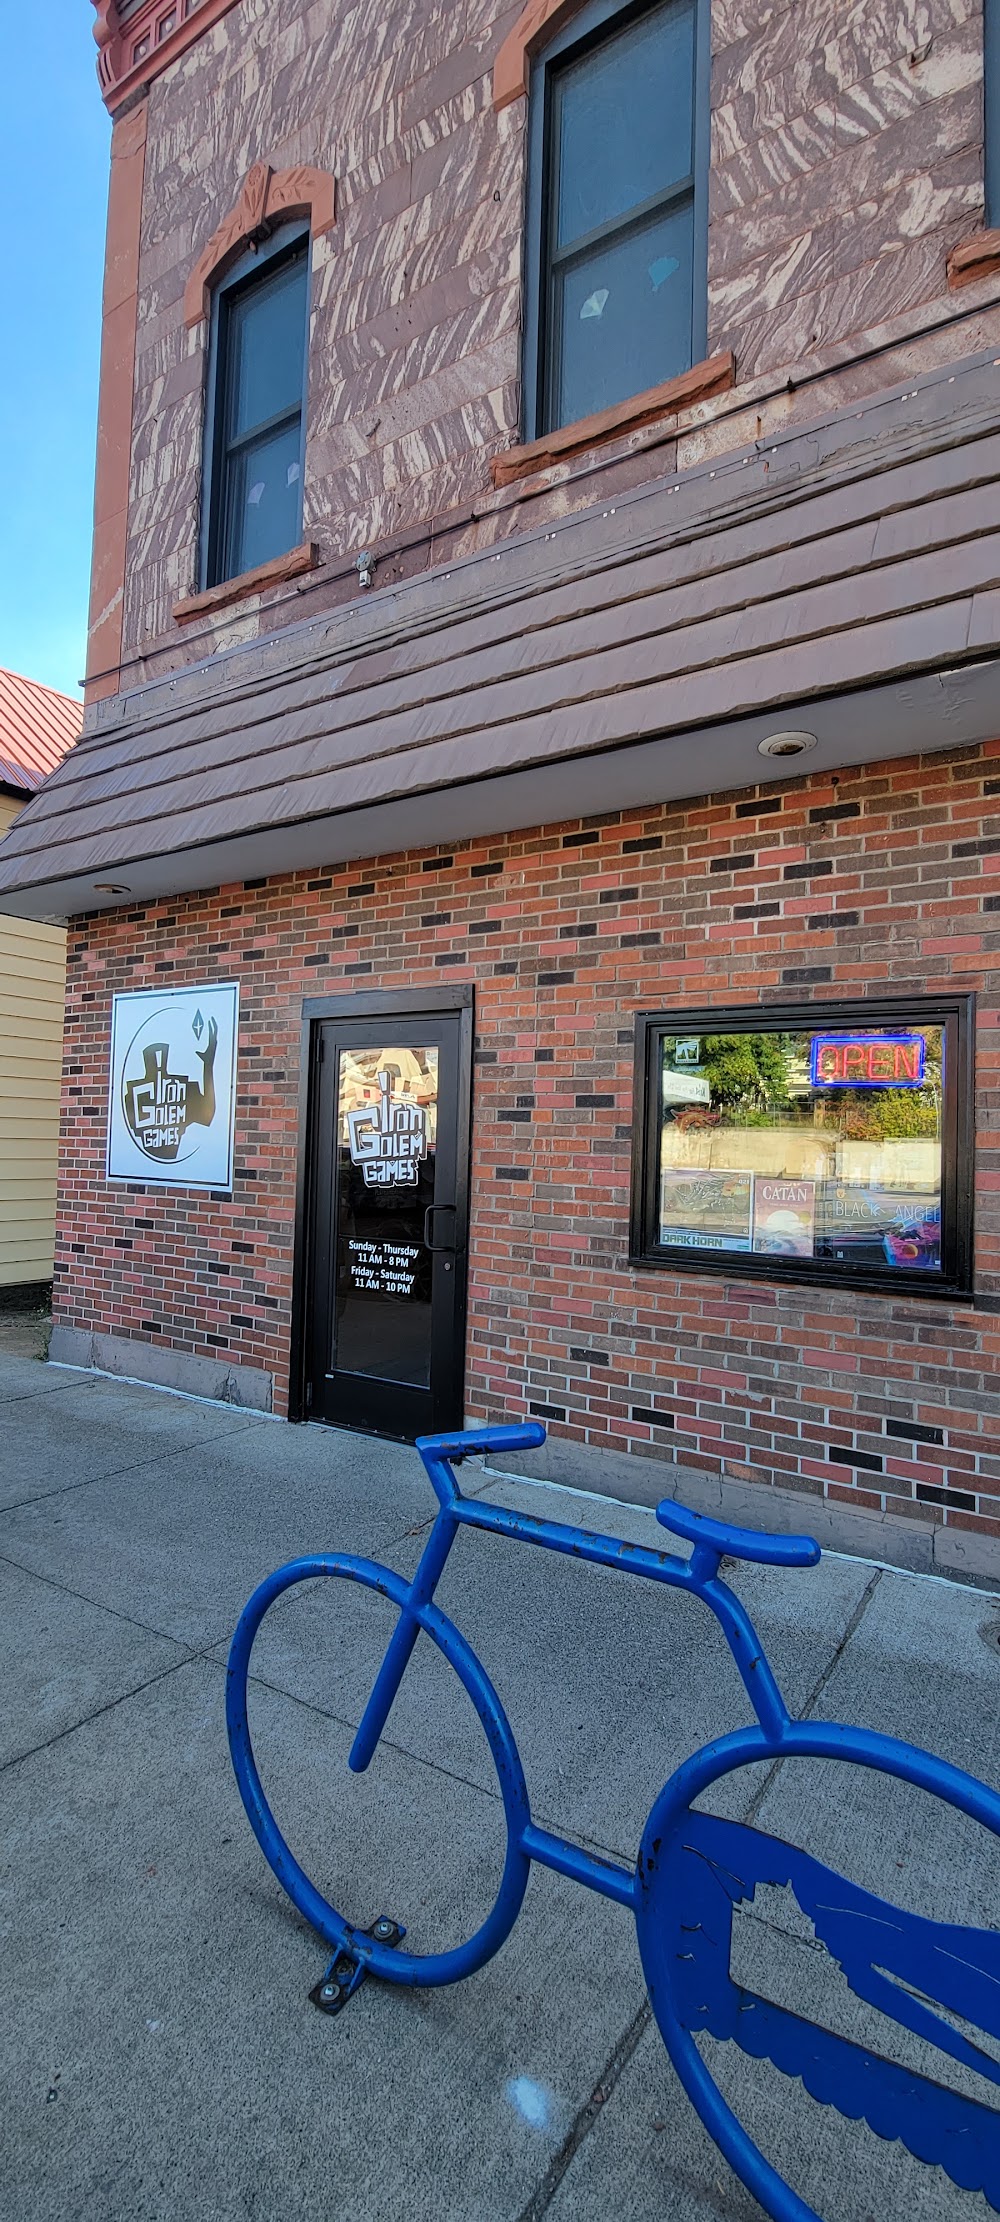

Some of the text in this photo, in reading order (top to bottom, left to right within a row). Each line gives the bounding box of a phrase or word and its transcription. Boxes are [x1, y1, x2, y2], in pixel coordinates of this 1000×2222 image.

[818, 1044, 919, 1079] OPEN
[763, 1186, 807, 1201] CATAN
[836, 1200, 940, 1222] BLACK ANGEL
[349, 1240, 377, 1253] Sunday
[383, 1244, 419, 1258] Thursday
[663, 1234, 722, 1247] DARK HORN
[358, 1253, 367, 1262] 11
[368, 1254, 382, 1264] AM
[389, 1256, 394, 1265] 8
[395, 1257, 409, 1268] PM
[351, 1266, 374, 1279] Friday
[380, 1269, 415, 1284] Saturday
[355, 1278, 365, 1287] 11
[365, 1280, 380, 1290] AM
[386, 1282, 395, 1291] 10
[396, 1283, 410, 1294] PM
